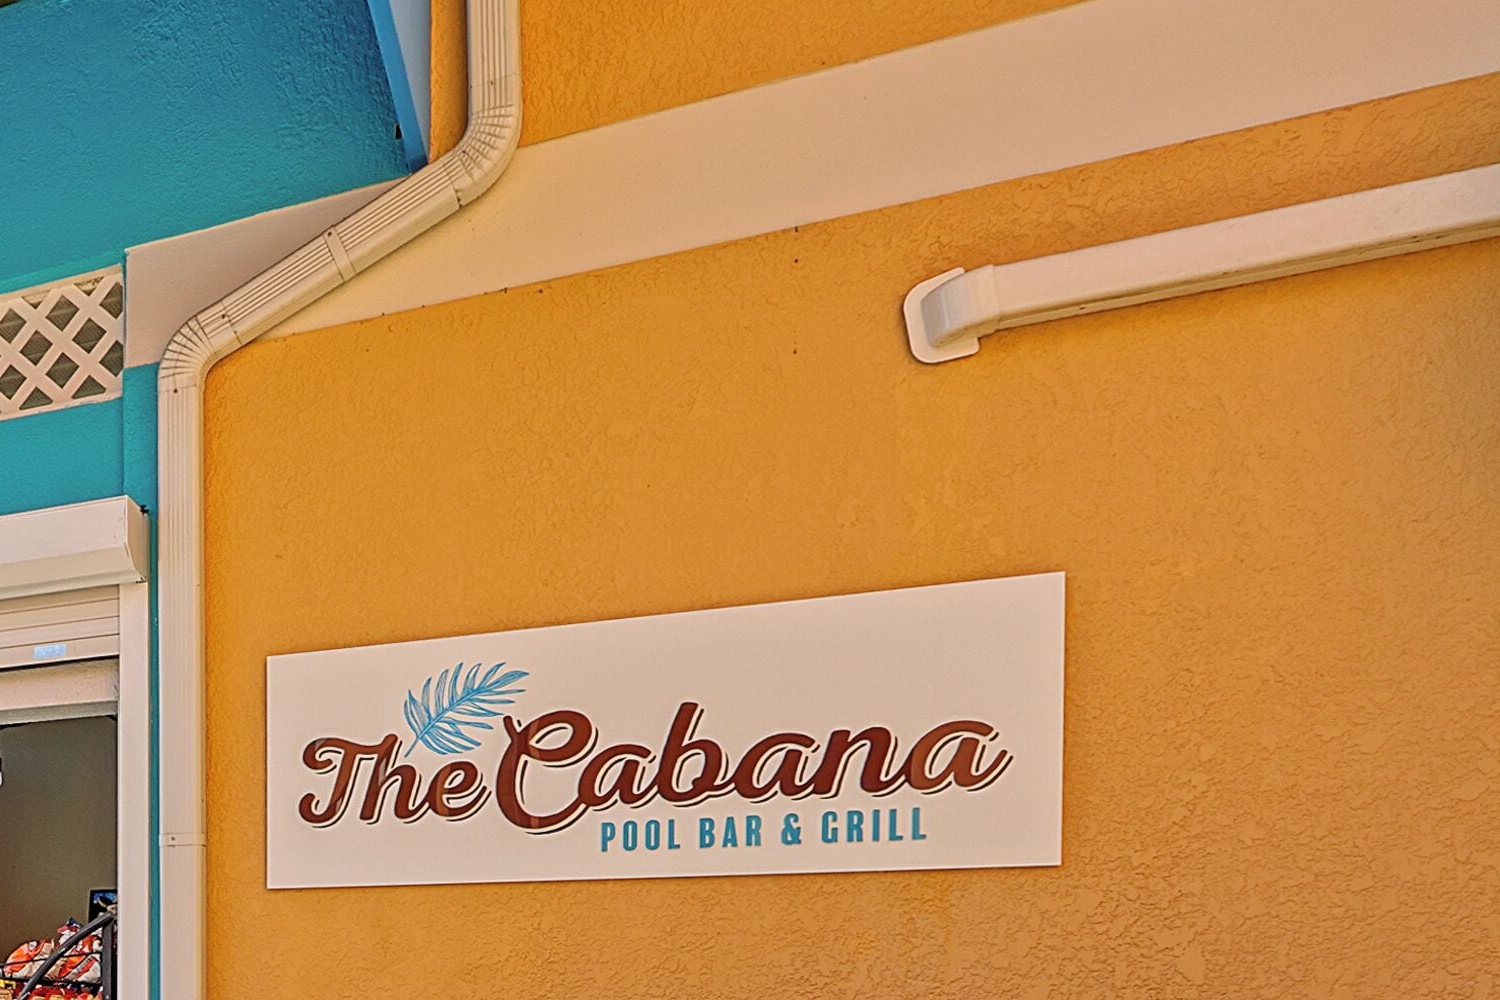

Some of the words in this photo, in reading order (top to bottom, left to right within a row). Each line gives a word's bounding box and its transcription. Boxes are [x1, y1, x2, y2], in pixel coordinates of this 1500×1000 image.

[299, 733, 492, 828] The
[496, 701, 1013, 835] Cabana
[601, 818, 681, 852] POOL
[699, 814, 762, 849] BAR
[780, 812, 803, 846] &
[820, 807, 928, 844] GRILL
